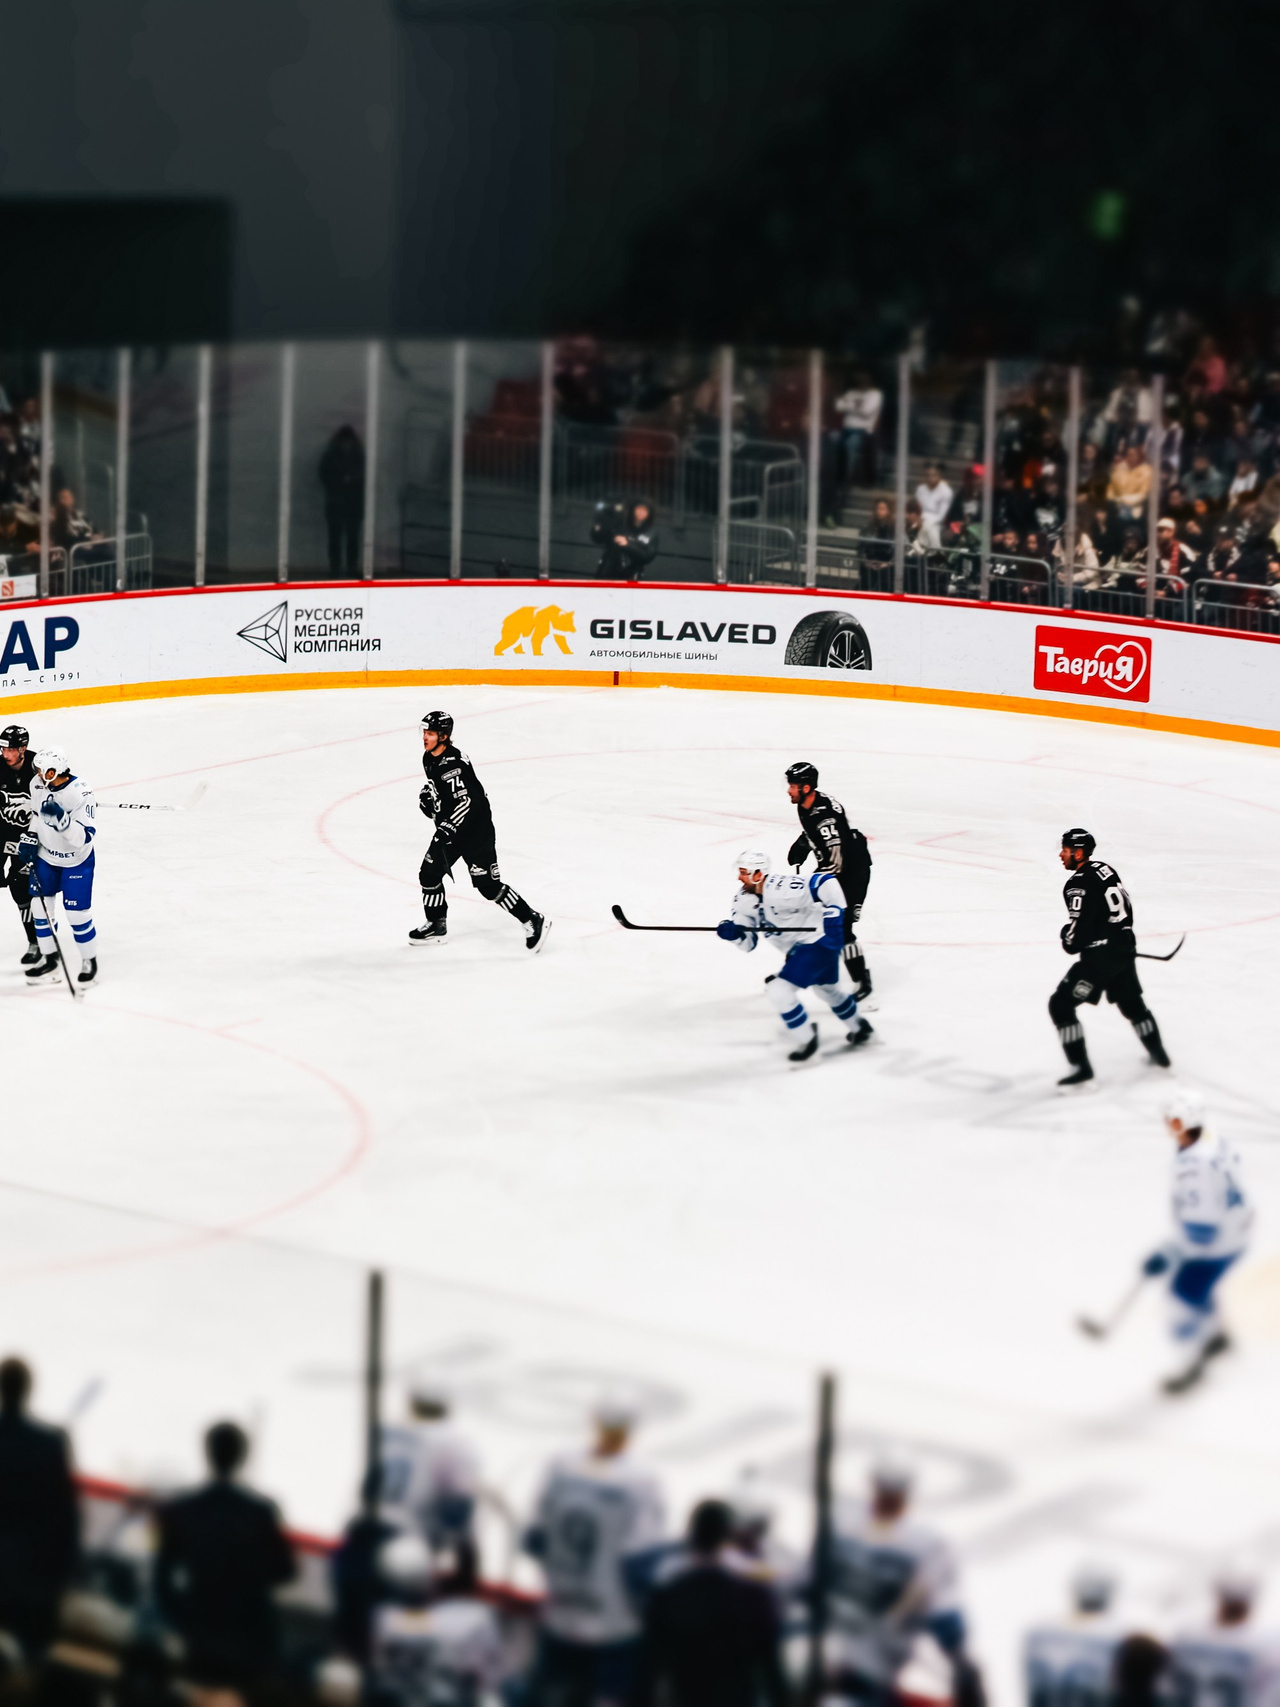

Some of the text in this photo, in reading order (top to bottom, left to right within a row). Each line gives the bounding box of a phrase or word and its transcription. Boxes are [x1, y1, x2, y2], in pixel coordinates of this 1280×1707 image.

[294, 607, 363, 621] РУССКАЯ
[294, 623, 360, 638] МЕДНАЯ
[589, 618, 778, 646] GISLAVED
[293, 638, 382, 654] КОМПАНИЯ
[589, 649, 719, 661] АВТОМОБИЛЬНЫЕ ШИНЫ
[53, 671, 81, 682] 1991
[446, 775, 466, 793] 74
[819, 824, 839, 841] 94
